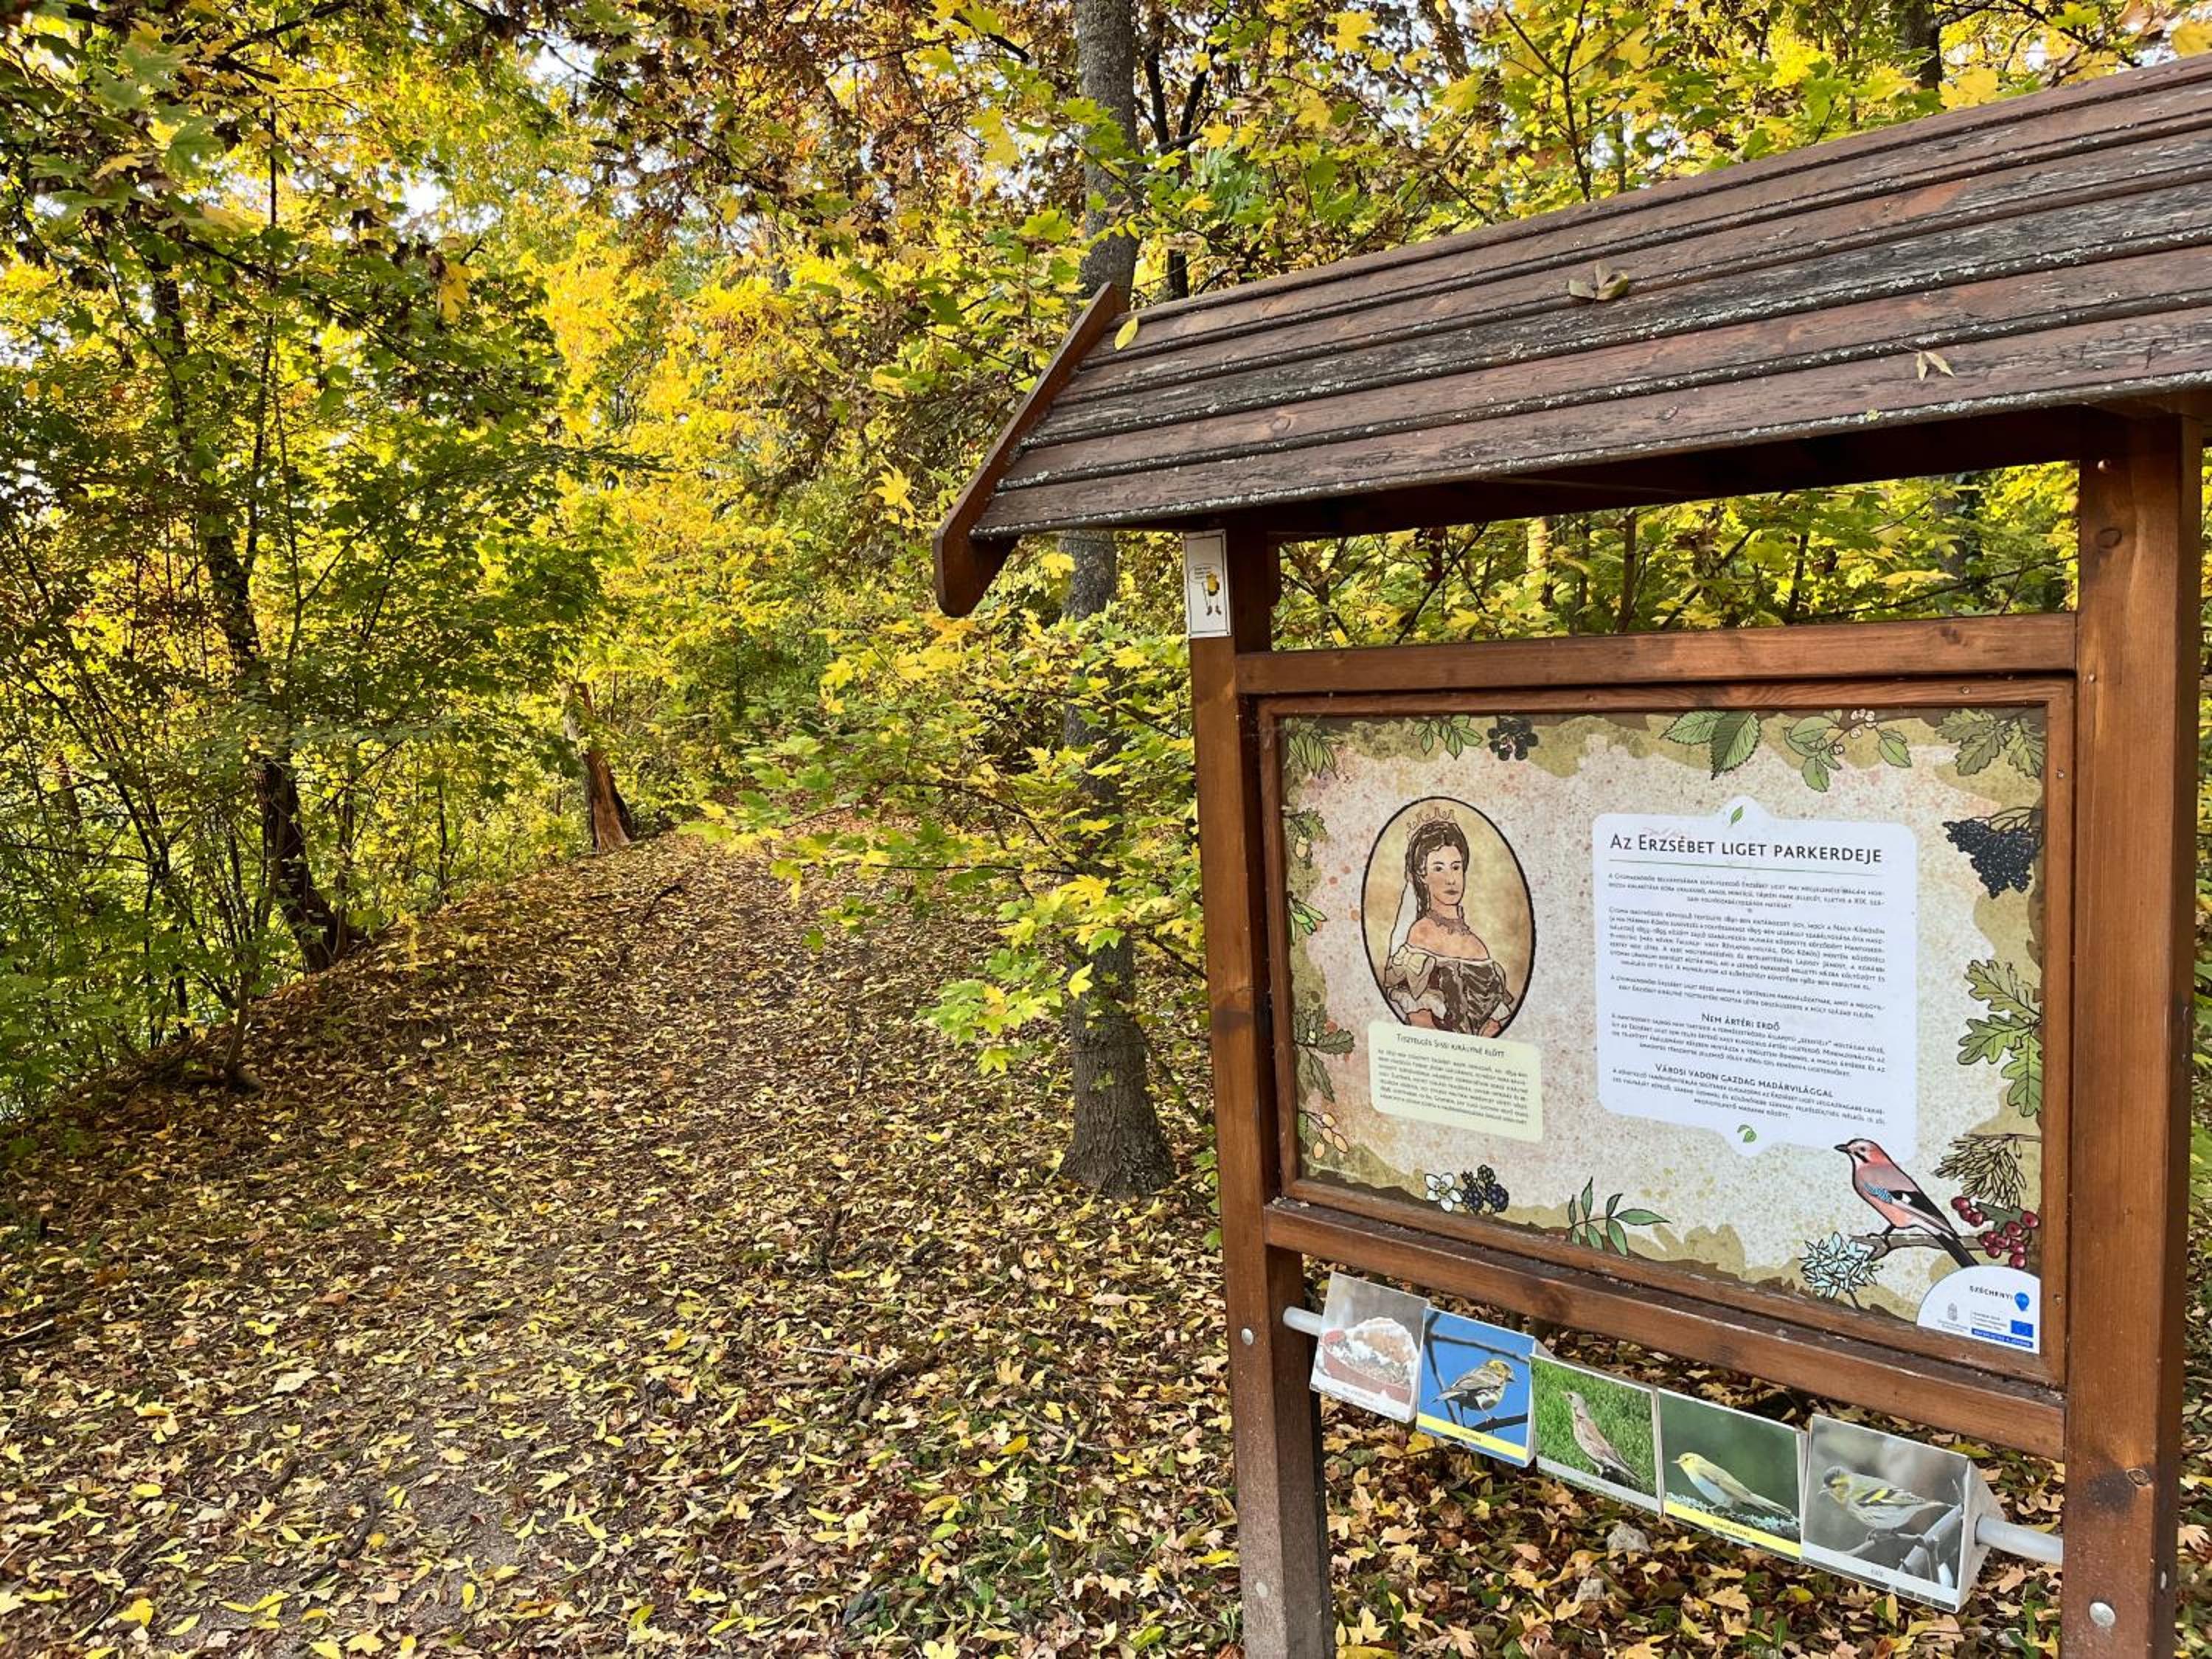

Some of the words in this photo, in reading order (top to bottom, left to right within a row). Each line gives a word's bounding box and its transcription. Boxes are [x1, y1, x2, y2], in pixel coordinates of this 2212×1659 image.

[1722, 843, 1767, 856] LIGET
[1774, 844, 1882, 864] PARKERDEJE
[1701, 1013, 1722, 1023] NEM
[1725, 1016, 1753, 1028] ÁRTÉRI
[1756, 1020, 1779, 1031] ERDŐ
[1655, 1062, 1686, 1076] VÁROSI
[1688, 1068, 1718, 1081] VADON
[1720, 1074, 1755, 1086] GAZDAG
[1758, 1078, 1832, 1098] MADÁRVILÁGGAL
